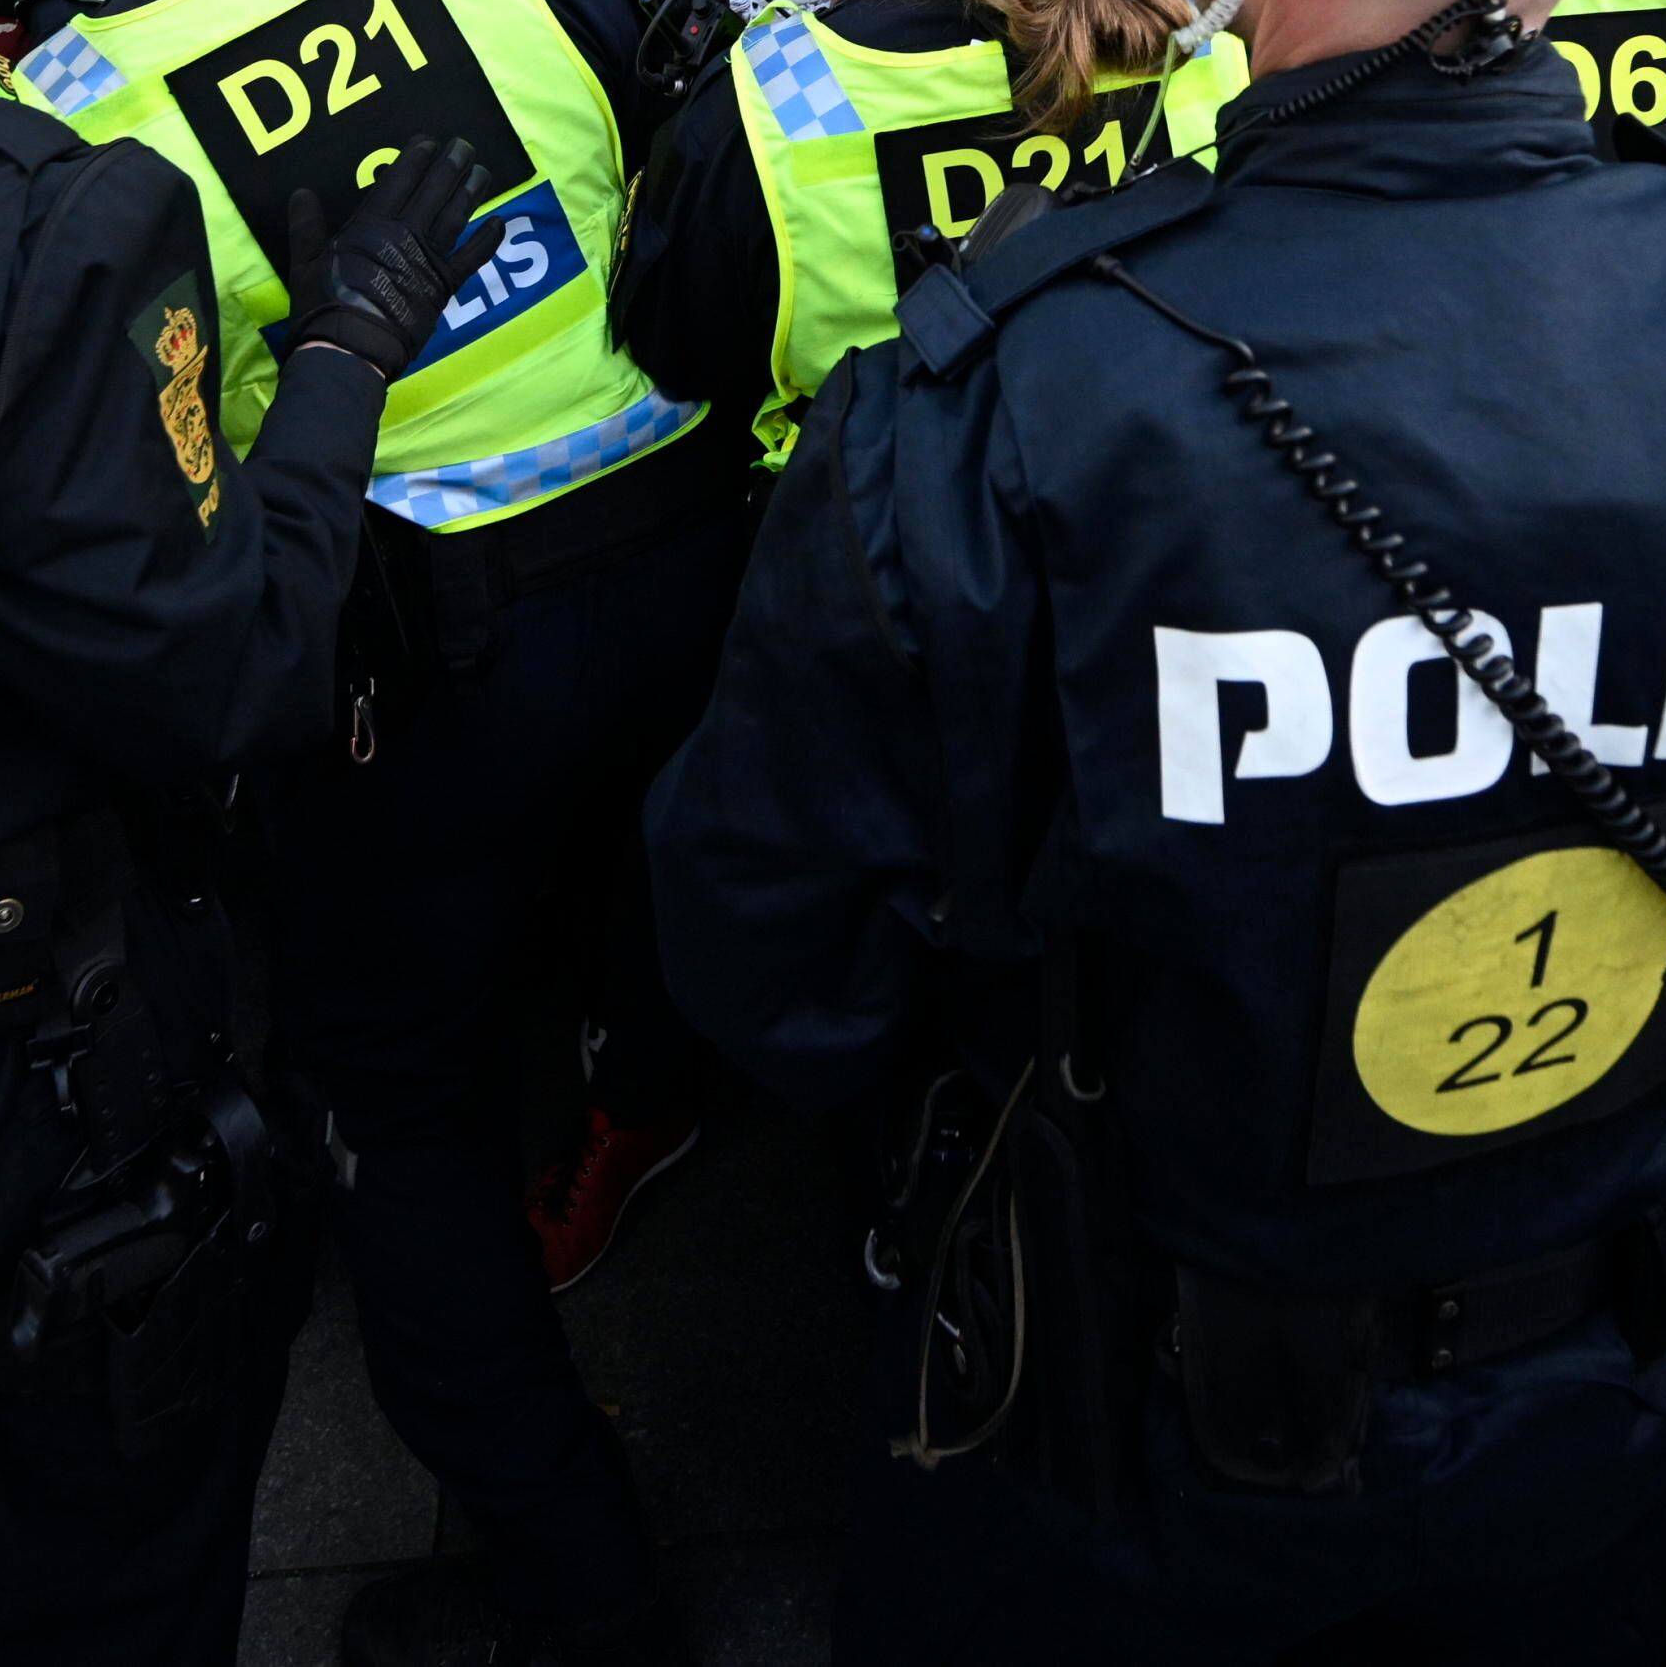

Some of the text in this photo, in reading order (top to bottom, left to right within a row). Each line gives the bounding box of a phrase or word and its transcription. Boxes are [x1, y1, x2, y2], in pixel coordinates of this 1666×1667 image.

[441, 216, 550, 331] LIS
[1513, 910, 1559, 988] 1
[1434, 997, 1590, 1095] 22
